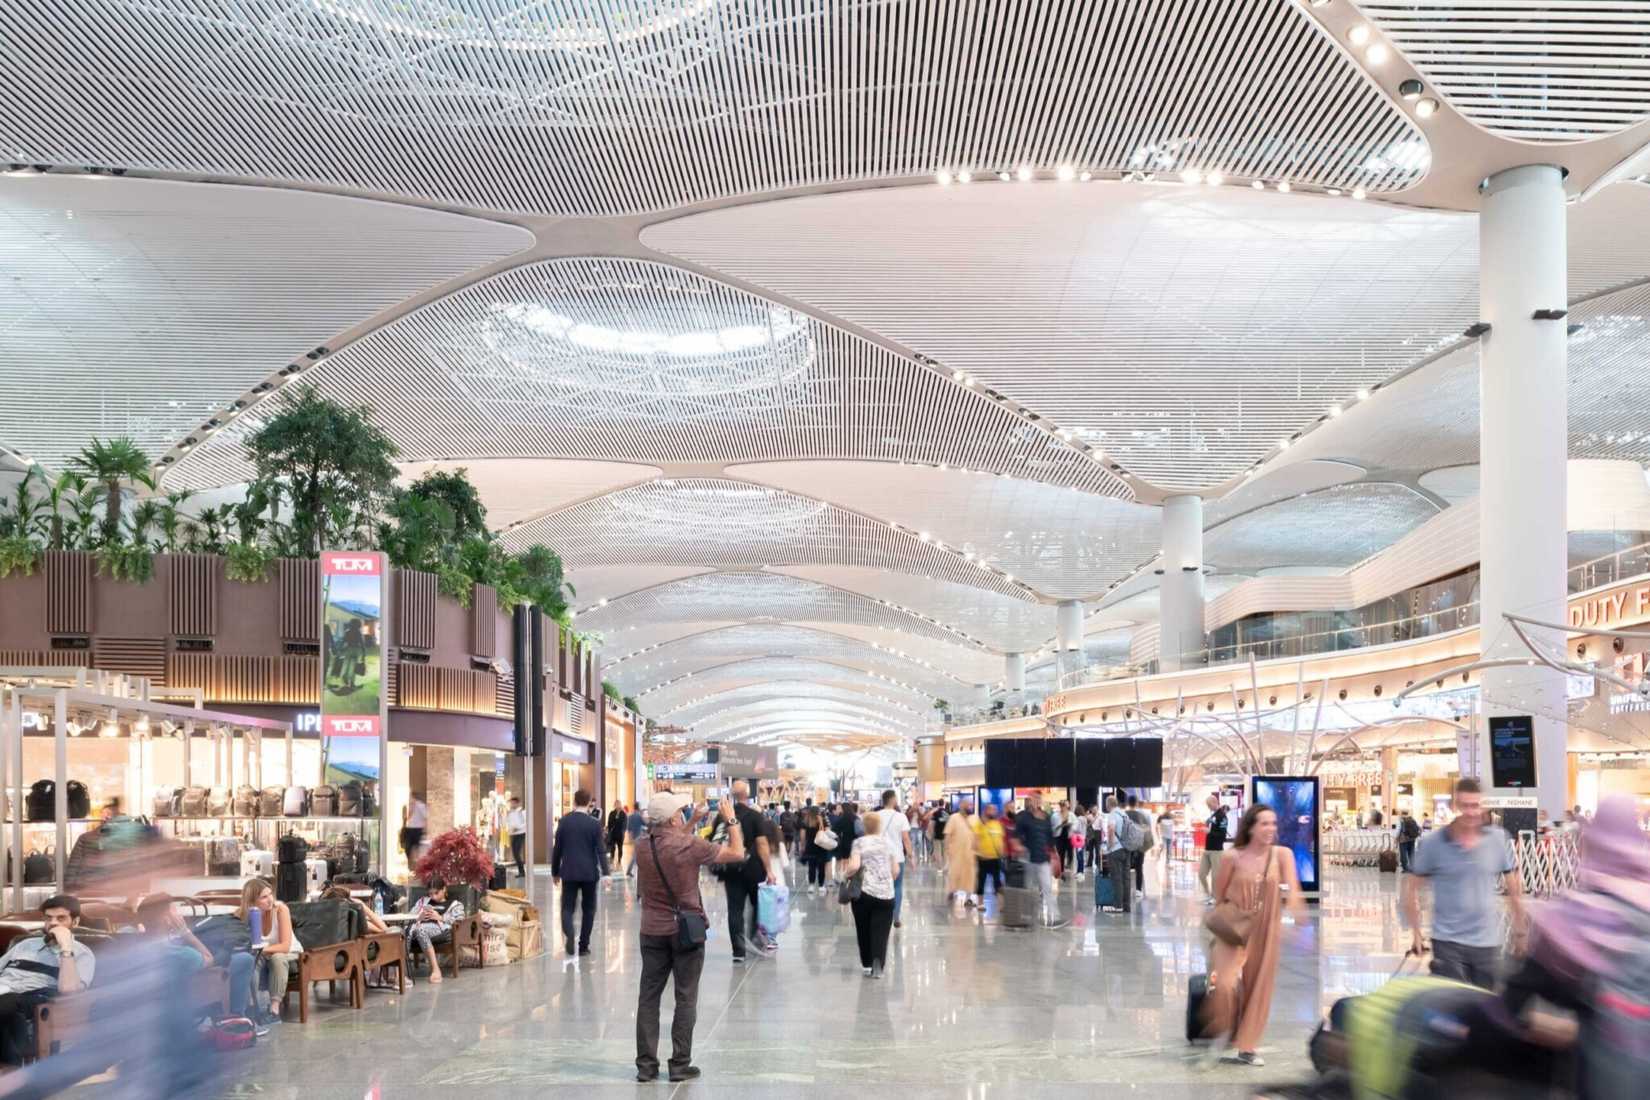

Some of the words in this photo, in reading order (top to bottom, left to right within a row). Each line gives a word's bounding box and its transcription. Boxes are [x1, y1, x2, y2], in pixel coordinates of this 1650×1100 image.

[331, 559, 373, 571] TUMI
[1569, 591, 1629, 628] DUTY
[331, 719, 373, 731] TUMI
